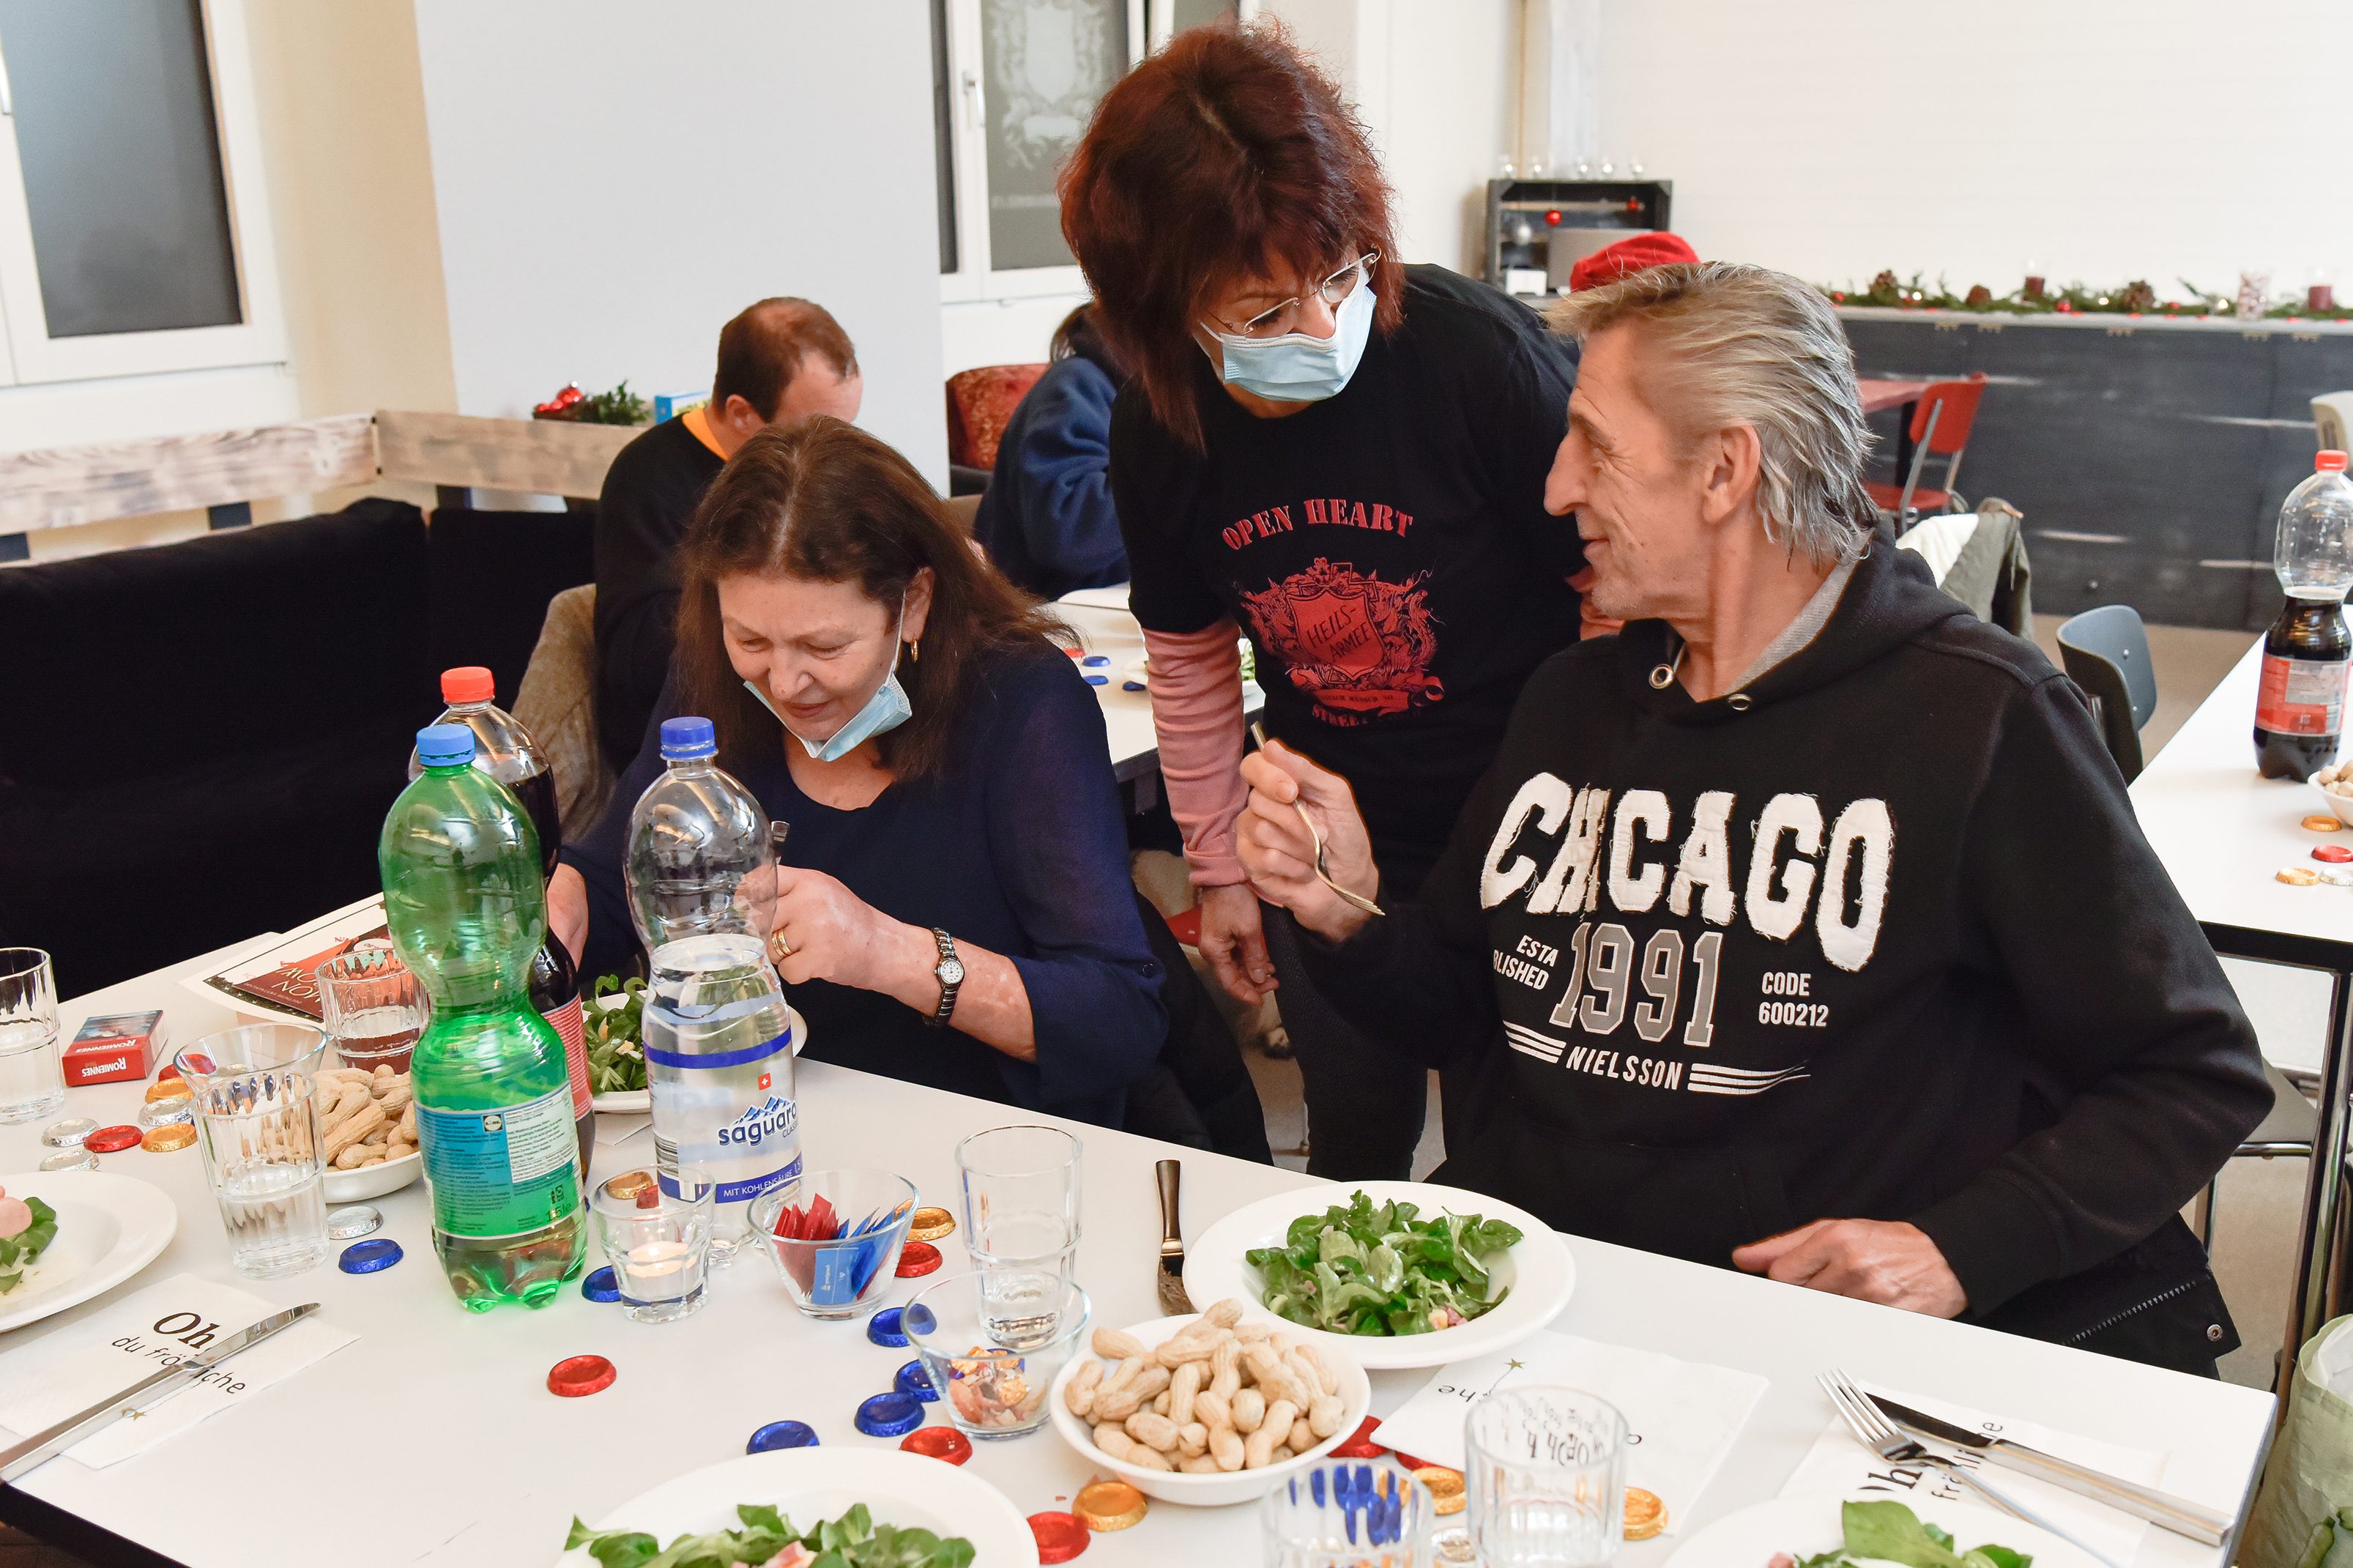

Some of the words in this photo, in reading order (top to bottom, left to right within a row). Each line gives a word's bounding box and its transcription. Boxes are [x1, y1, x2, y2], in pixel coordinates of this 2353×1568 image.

[1222, 505, 1293, 551] OPEN
[1304, 499, 1413, 538] HEART
[1306, 605, 1356, 648] HEILS-
[1329, 622, 1372, 659] ARMEE
[1516, 935, 1559, 967] ESTA
[1549, 923, 1723, 1047] 1991
[1761, 972, 1812, 997] CODE
[1758, 1001, 1829, 1027] 600212
[75, 1039, 136, 1053] ROMIENNES
[81, 1057, 127, 1077] ROMIENNES
[1565, 1046, 1682, 1090] NIELSSON
[718, 1101, 797, 1146] saguaro
[724, 1188, 740, 1197] MIT
[111, 1336, 146, 1353] du
